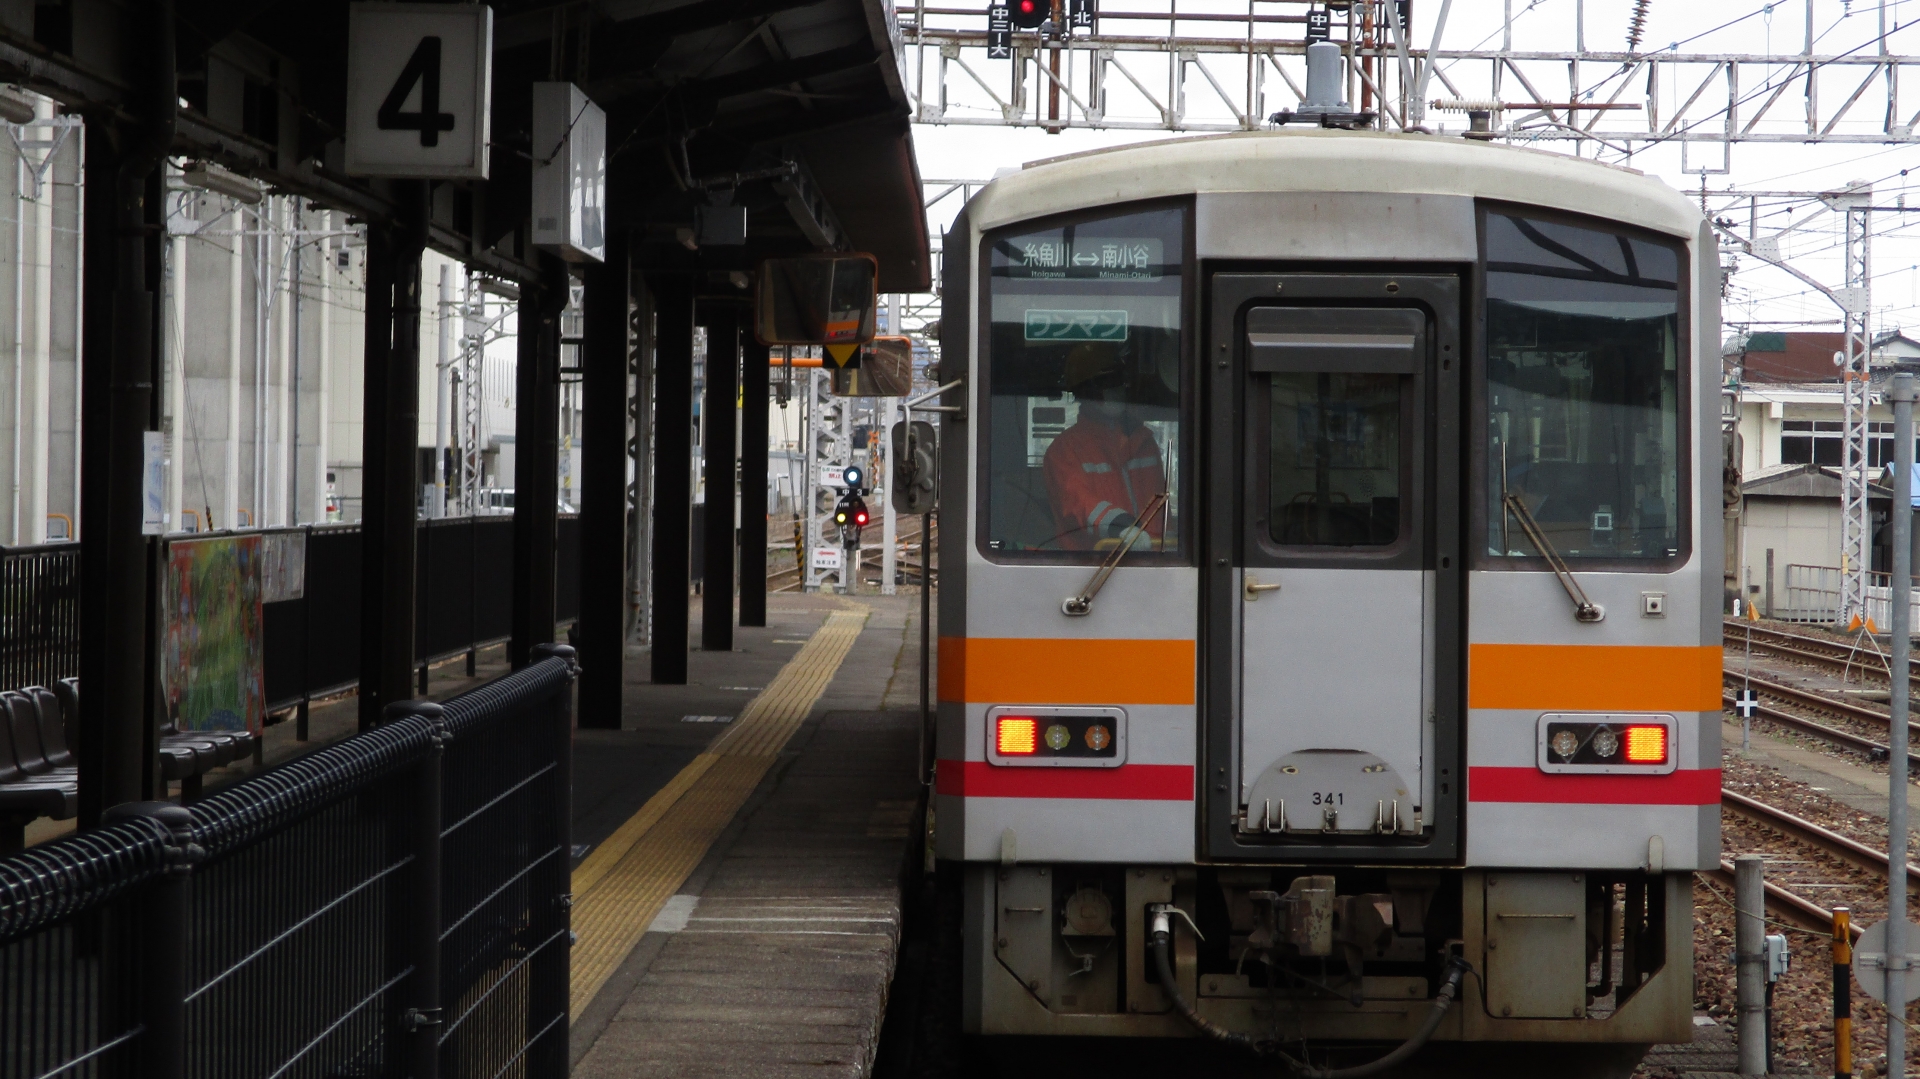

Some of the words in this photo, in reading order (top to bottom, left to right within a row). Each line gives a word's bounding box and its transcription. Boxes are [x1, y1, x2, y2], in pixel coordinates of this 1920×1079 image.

[377, 36, 455, 147] 4
[1023, 243, 1070, 268] 糸魚川
[1102, 243, 1149, 268] 南小谷
[1031, 270, 1066, 279] Itoigawa
[1100, 271, 1151, 279] Minami-Otari
[1029, 314, 1122, 337] ワンマン
[856, 488, 863, 497] 3
[1312, 792, 1343, 806] 341
